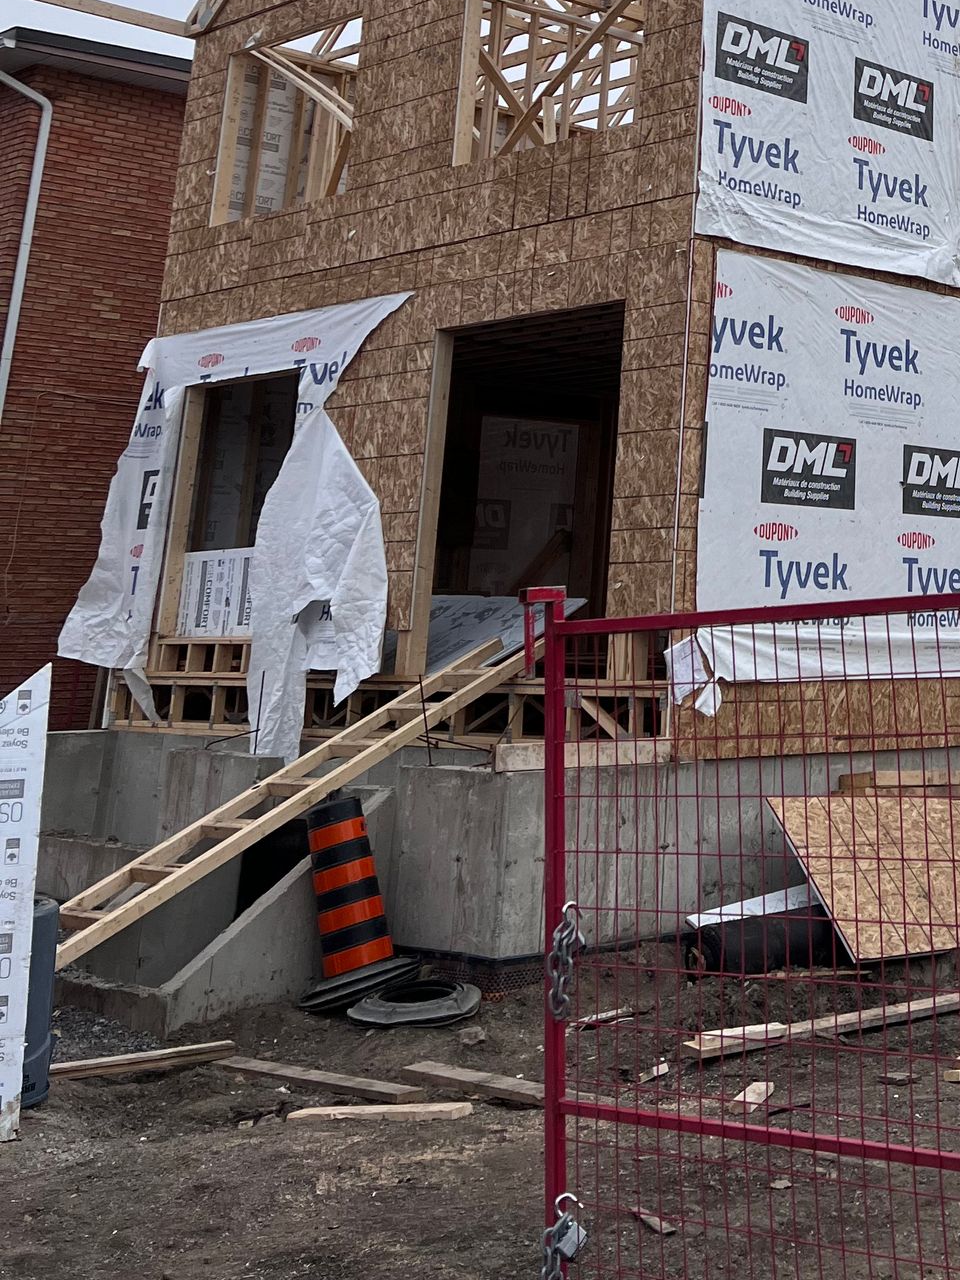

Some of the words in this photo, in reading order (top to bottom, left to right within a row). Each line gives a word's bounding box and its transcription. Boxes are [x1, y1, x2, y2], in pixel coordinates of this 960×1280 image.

[721, 21, 800, 73] DML
[712, 96, 748, 117] DUPONT
[858, 66, 926, 113] DML
[713, 119, 799, 173] Tyvek
[852, 136, 882, 154] DUPONT
[718, 170, 800, 208] HomeWrap
[853, 158, 928, 207] Tyvek
[857, 204, 930, 238] HomeWrap
[839, 306, 870, 324] DUPONT
[713, 315, 784, 353] yvek
[840, 328, 919, 375] Tyvek
[710, 363, 786, 390] omeWrap
[844, 379, 921, 409] HomeWrap
[767, 437, 848, 478] DML
[784, 489, 806, 500] Building
[807, 491, 829, 501] Supplies
[801, 480, 807, 488] de
[808, 481, 840, 490] construction
[760, 523, 794, 541] DUPONT
[902, 532, 931, 549] DUPONT
[760, 550, 848, 599] Tyvek
